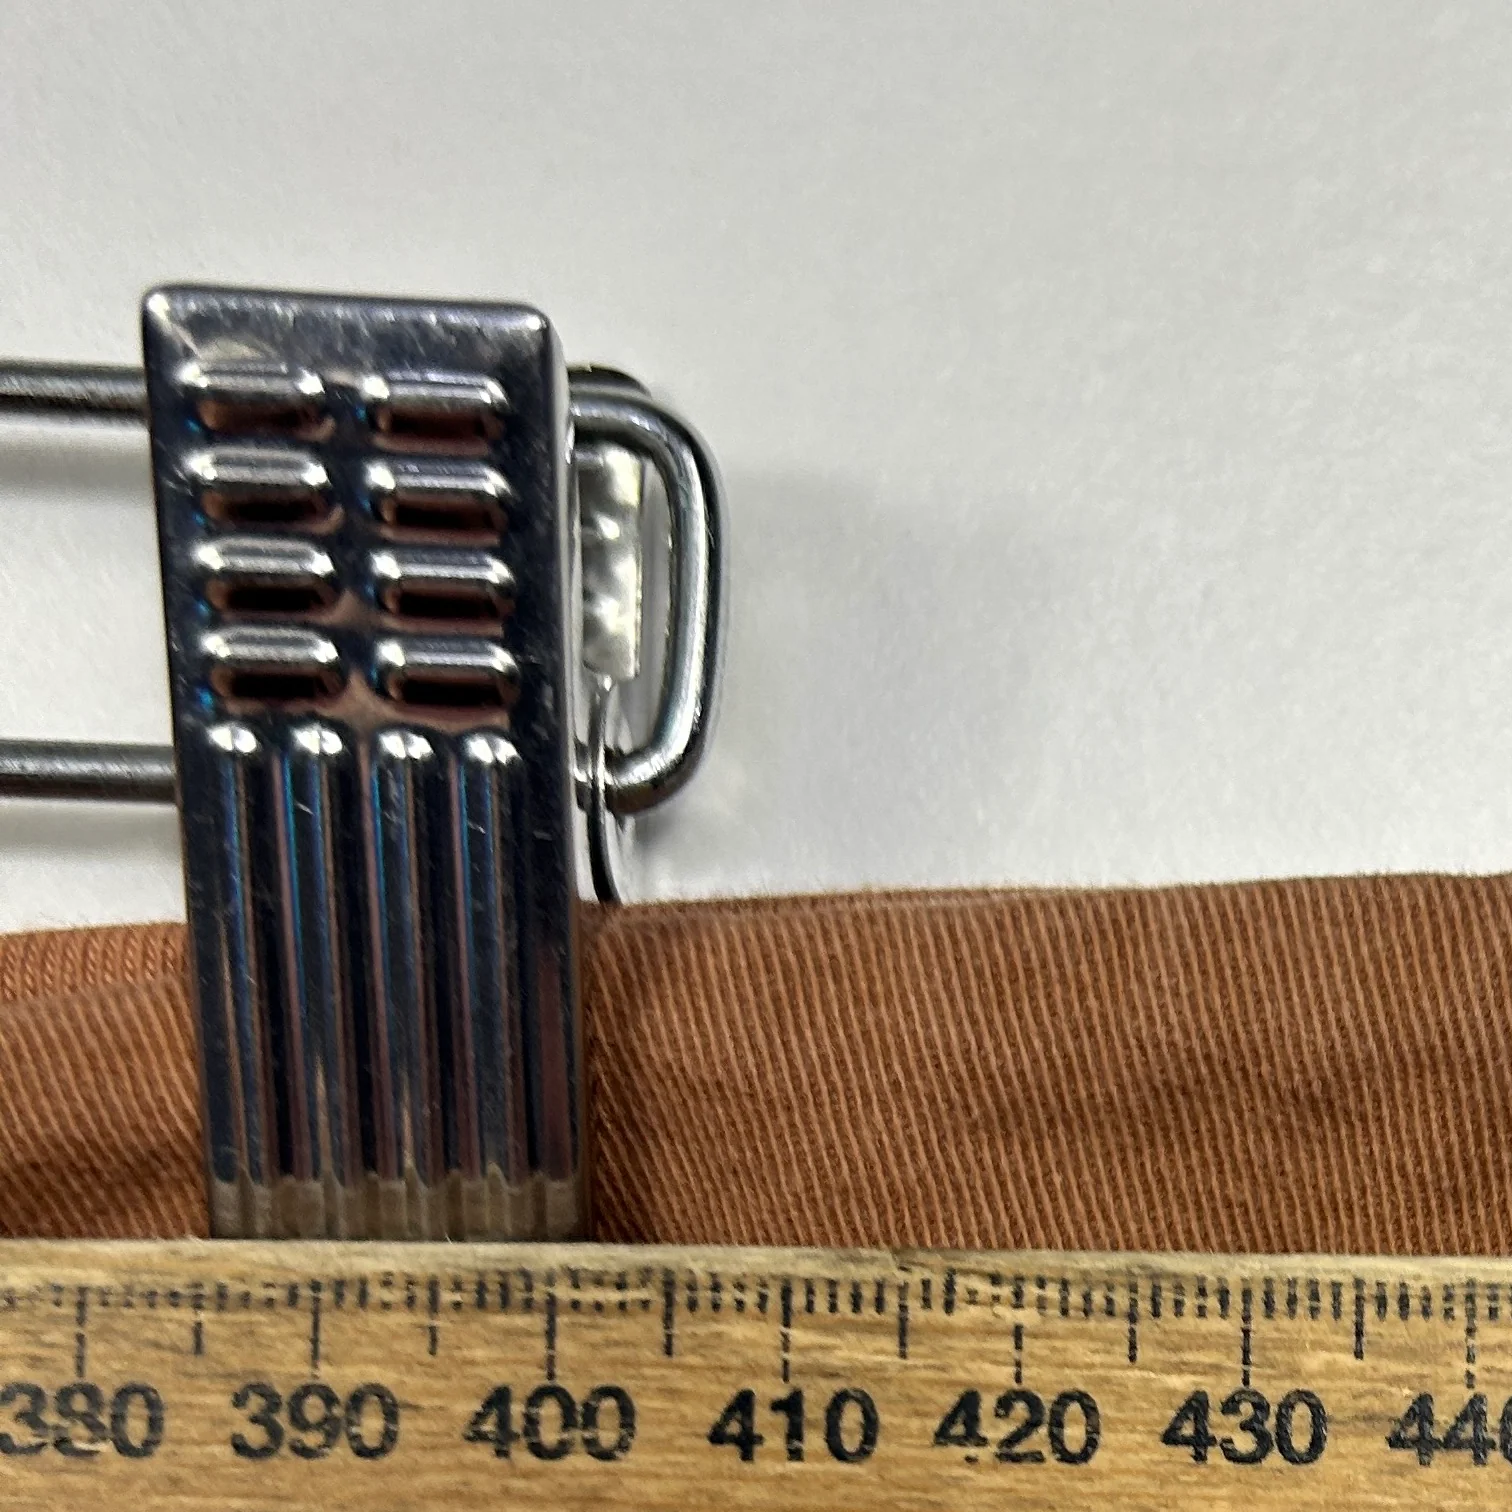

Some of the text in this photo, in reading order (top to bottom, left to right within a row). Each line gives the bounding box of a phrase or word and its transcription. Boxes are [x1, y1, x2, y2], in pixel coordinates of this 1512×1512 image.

[0, 1382, 165, 1459] 380
[231, 1382, 400, 1460] 390
[463, 1383, 637, 1462] 400
[707, 1387, 880, 1464] 410
[934, 1388, 1101, 1466] 420
[1161, 1389, 1328, 1466] 430
